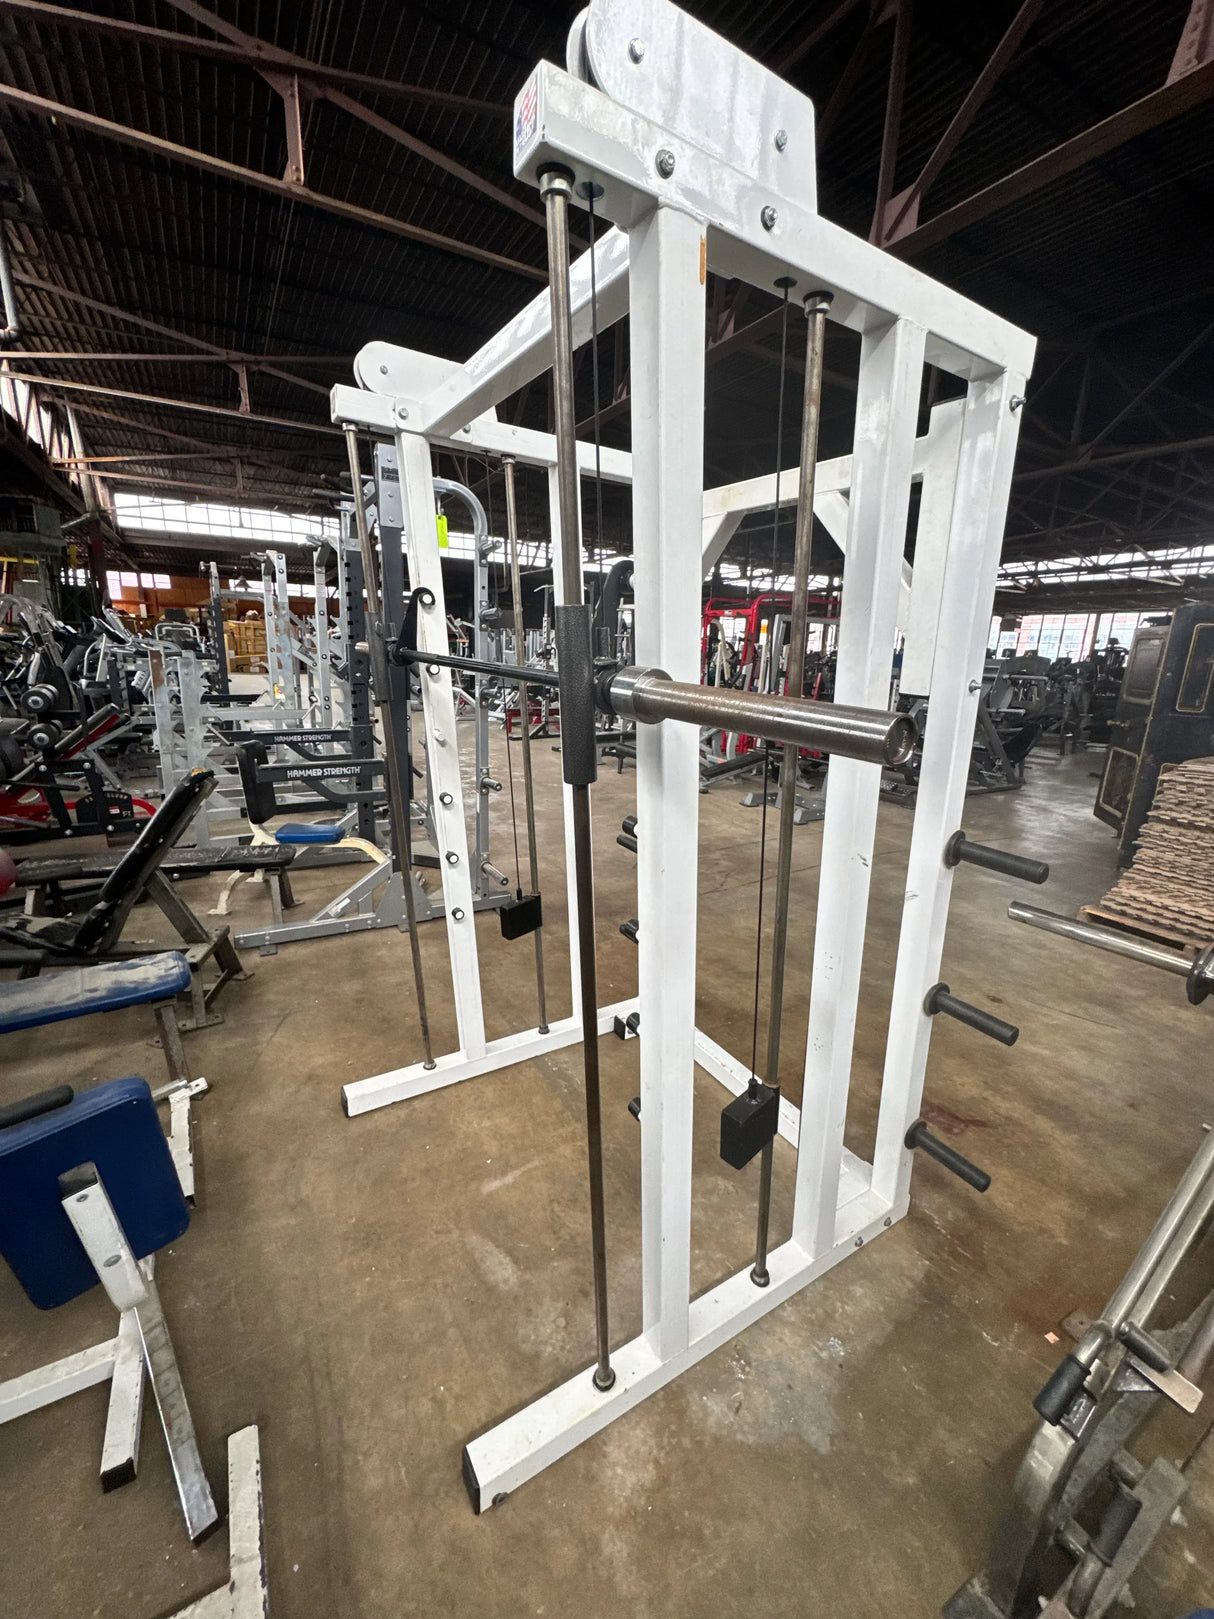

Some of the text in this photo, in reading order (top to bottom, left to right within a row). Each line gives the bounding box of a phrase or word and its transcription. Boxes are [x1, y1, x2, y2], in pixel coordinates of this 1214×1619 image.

[274, 735, 301, 743] HAMMER
[287, 766, 360, 778] HAMMER STRENGTH
